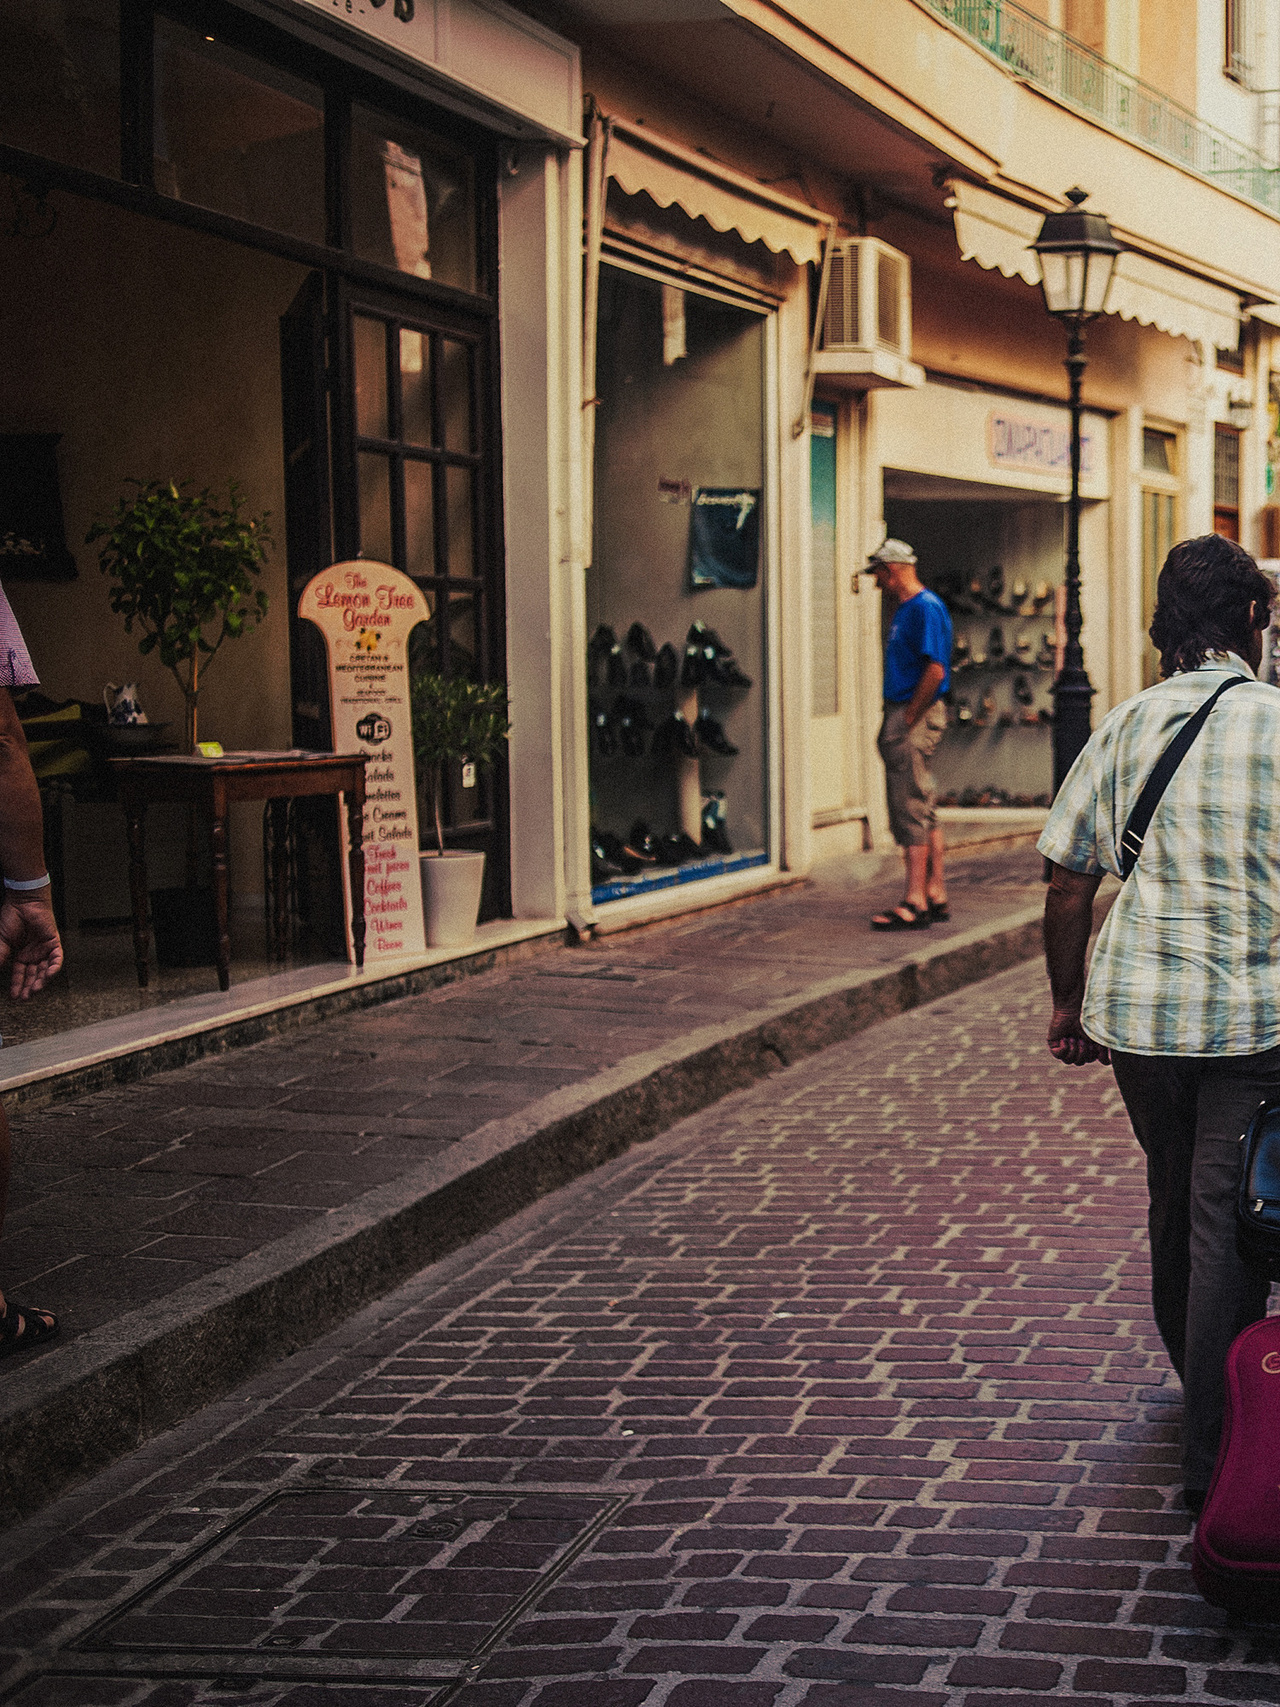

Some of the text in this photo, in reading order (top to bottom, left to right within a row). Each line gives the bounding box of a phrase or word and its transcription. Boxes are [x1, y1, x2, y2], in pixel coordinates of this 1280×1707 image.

[344, 571, 368, 590] The
[315, 582, 416, 610] Lemon Tree
[342, 607, 392, 632] Garden
[335, 664, 403, 673] MEDITERRANEAN
[366, 767, 395, 781] alads
